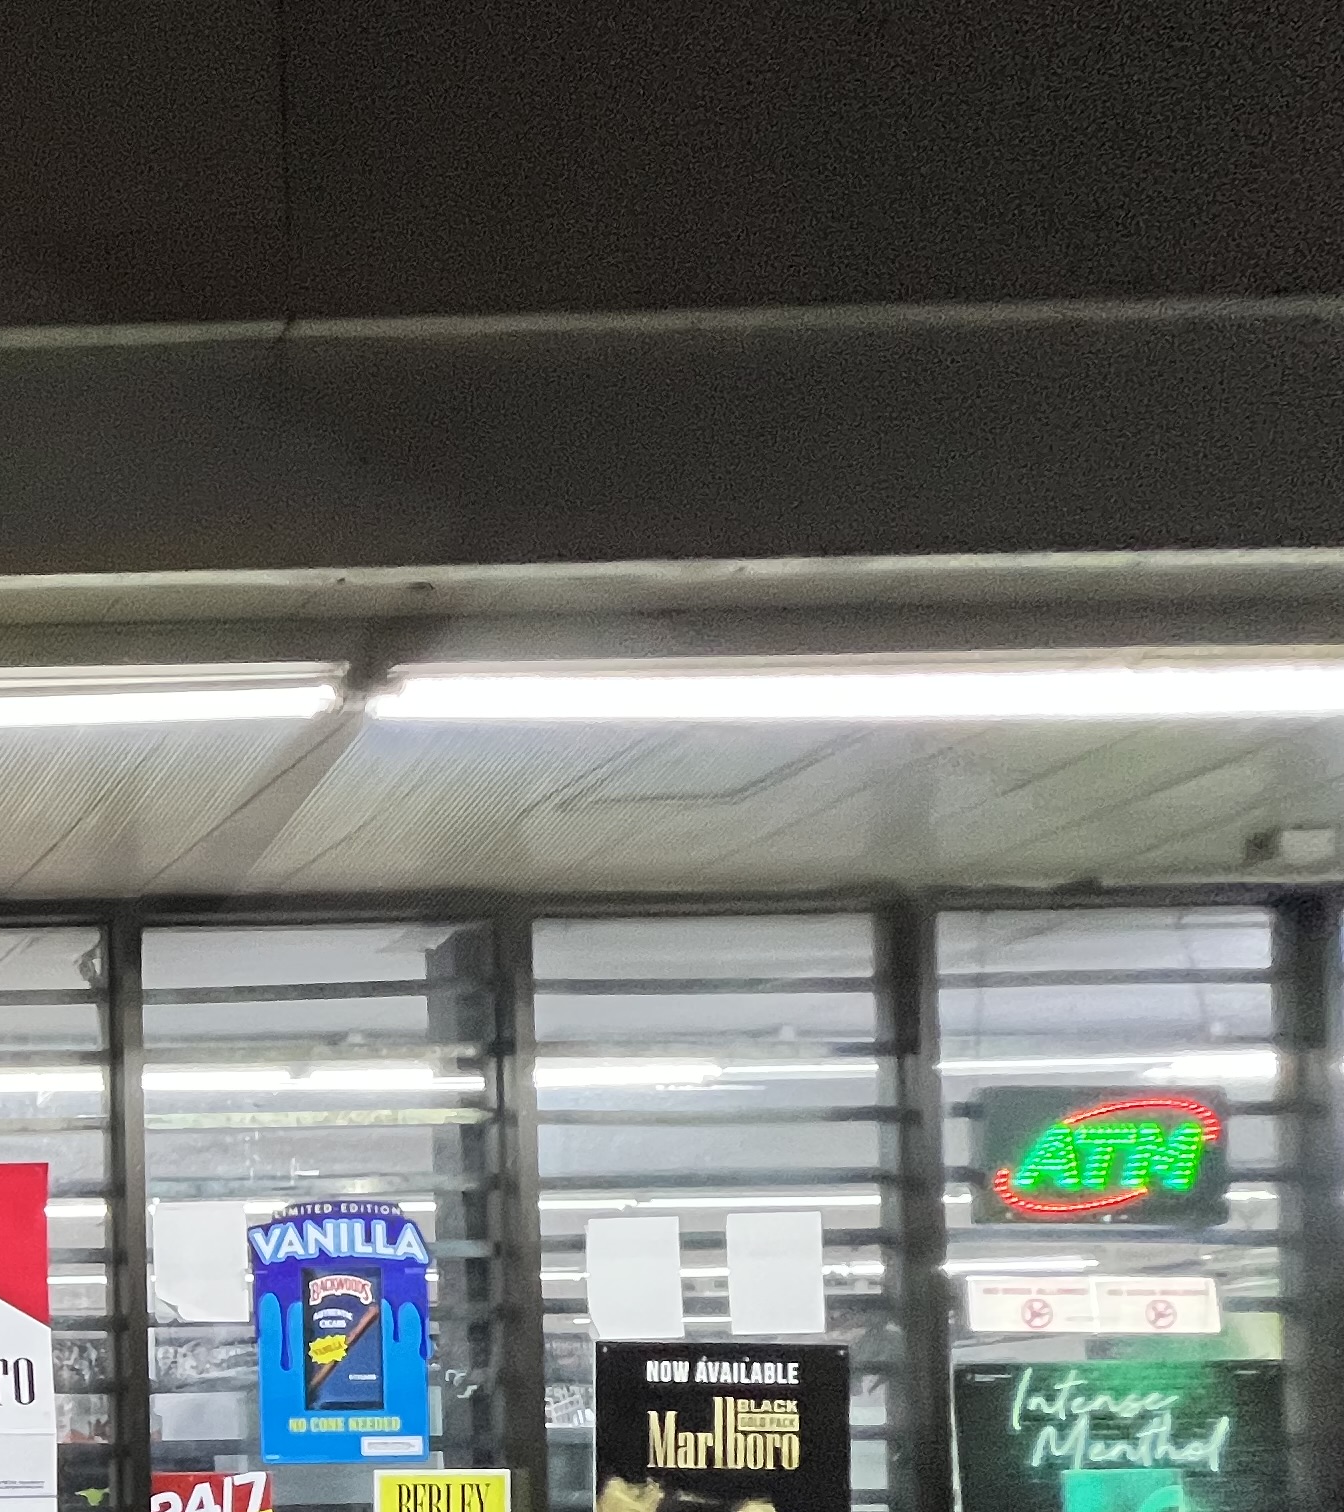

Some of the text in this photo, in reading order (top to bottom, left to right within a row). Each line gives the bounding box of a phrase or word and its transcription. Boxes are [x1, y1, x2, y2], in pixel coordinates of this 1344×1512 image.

[1013, 1121, 1202, 1191] ATM
[274, 1203, 401, 1219] LIMITED EDITION
[253, 1219, 427, 1263] VANILLA
[310, 1276, 373, 1304] BACKWOODS
[646, 1360, 800, 1385] NOW AVAILABLE
[737, 1398, 799, 1413] BLACK
[1011, 1367, 1180, 1430] Intense
[646, 1396, 800, 1470] Marlboro
[1030, 1412, 1230, 1473] Menthol
